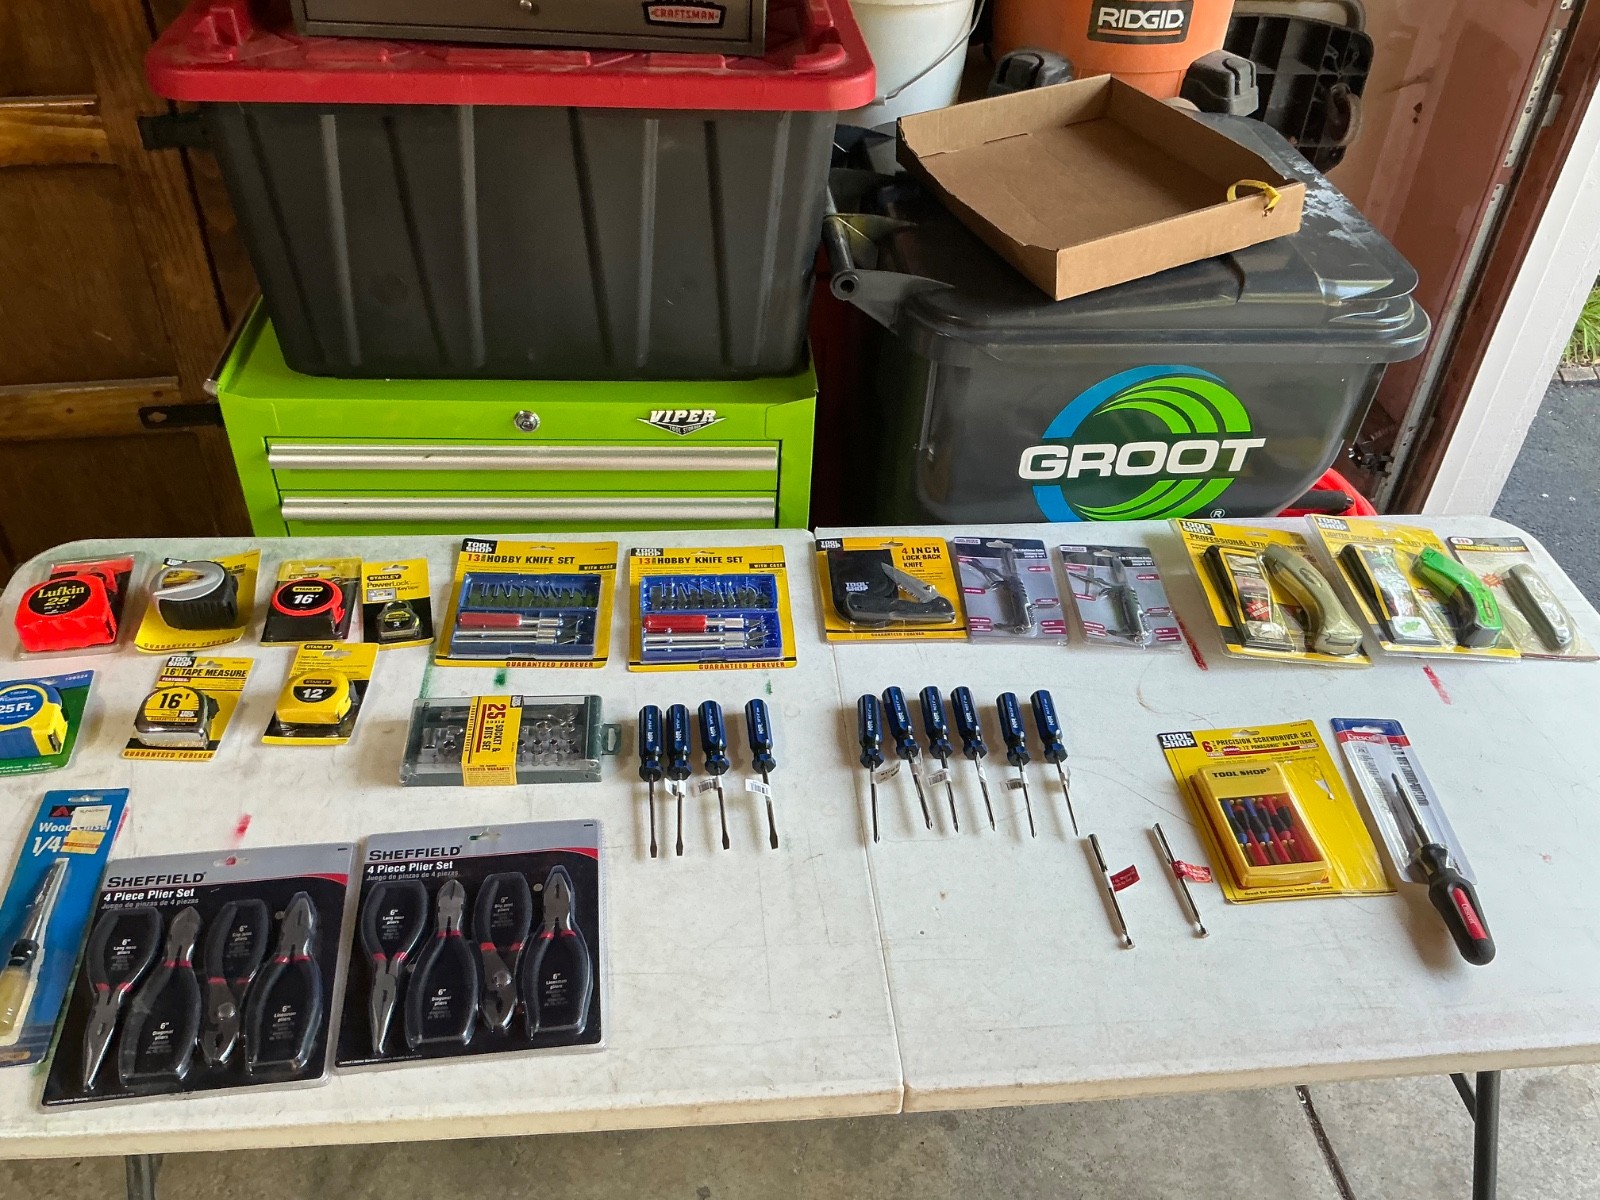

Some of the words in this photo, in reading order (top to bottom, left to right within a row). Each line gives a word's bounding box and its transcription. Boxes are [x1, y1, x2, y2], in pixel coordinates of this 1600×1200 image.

[654, 8, 715, 20] CRAFTSMAN
[1097, 7, 1184, 29] RIDGID
[649, 410, 717, 423] VIPER
[1018, 437, 1267, 480] GROOT
[1181, 521, 1210, 530] TOOL
[1318, 517, 1340, 525] TOOL
[1319, 522, 1347, 530] SHOP
[1183, 526, 1212, 535] SHOP
[1189, 534, 1248, 548] PROFESSIONAL
[467, 554, 480, 562] 13
[487, 555, 521, 564] HOBBY
[525, 556, 554, 564] KNIFE
[557, 557, 576, 565] SET
[695, 556, 723, 564] KNIFE
[727, 556, 744, 564] SET
[367, 580, 409, 588] PowerLock
[38, 586, 85, 598] Lufkin
[294, 594, 320, 605] 16'
[181, 668, 204, 676] TAPE
[205, 668, 248, 677] MEASURE
[302, 688, 327, 699] 12'
[159, 693, 191, 709] 16'
[486, 703, 507, 720] 25
[483, 726, 494, 739] BITS
[493, 724, 504, 745] SOCKET
[1159, 733, 1192, 742] TOOL
[481, 740, 492, 751] SET
[1162, 739, 1196, 748] SHOP
[1201, 741, 1213, 752] 6
[1216, 738, 1252, 746] PRECISION
[1252, 732, 1299, 743] SCREWDRIVER
[1289, 738, 1317, 746] BATTERIES
[39, 822, 72, 832] Wood
[369, 846, 461, 861] SHEFFIELD
[367, 865, 374, 874] 4
[377, 864, 406, 874] Piece
[408, 862, 434, 872] Plier
[436, 861, 453, 870] Set
[107, 873, 204, 888] SHEFFIELD
[366, 874, 387, 882] Juego
[398, 873, 420, 881] pinzas
[437, 870, 459, 879] piezas
[104, 893, 111, 901] 4
[113, 890, 145, 902] Piece
[148, 888, 174, 900] Plier
[176, 887, 195, 898] Set
[101, 903, 124, 911] Juego
[135, 901, 157, 909] pinzas
[176, 899, 199, 907] piezas
